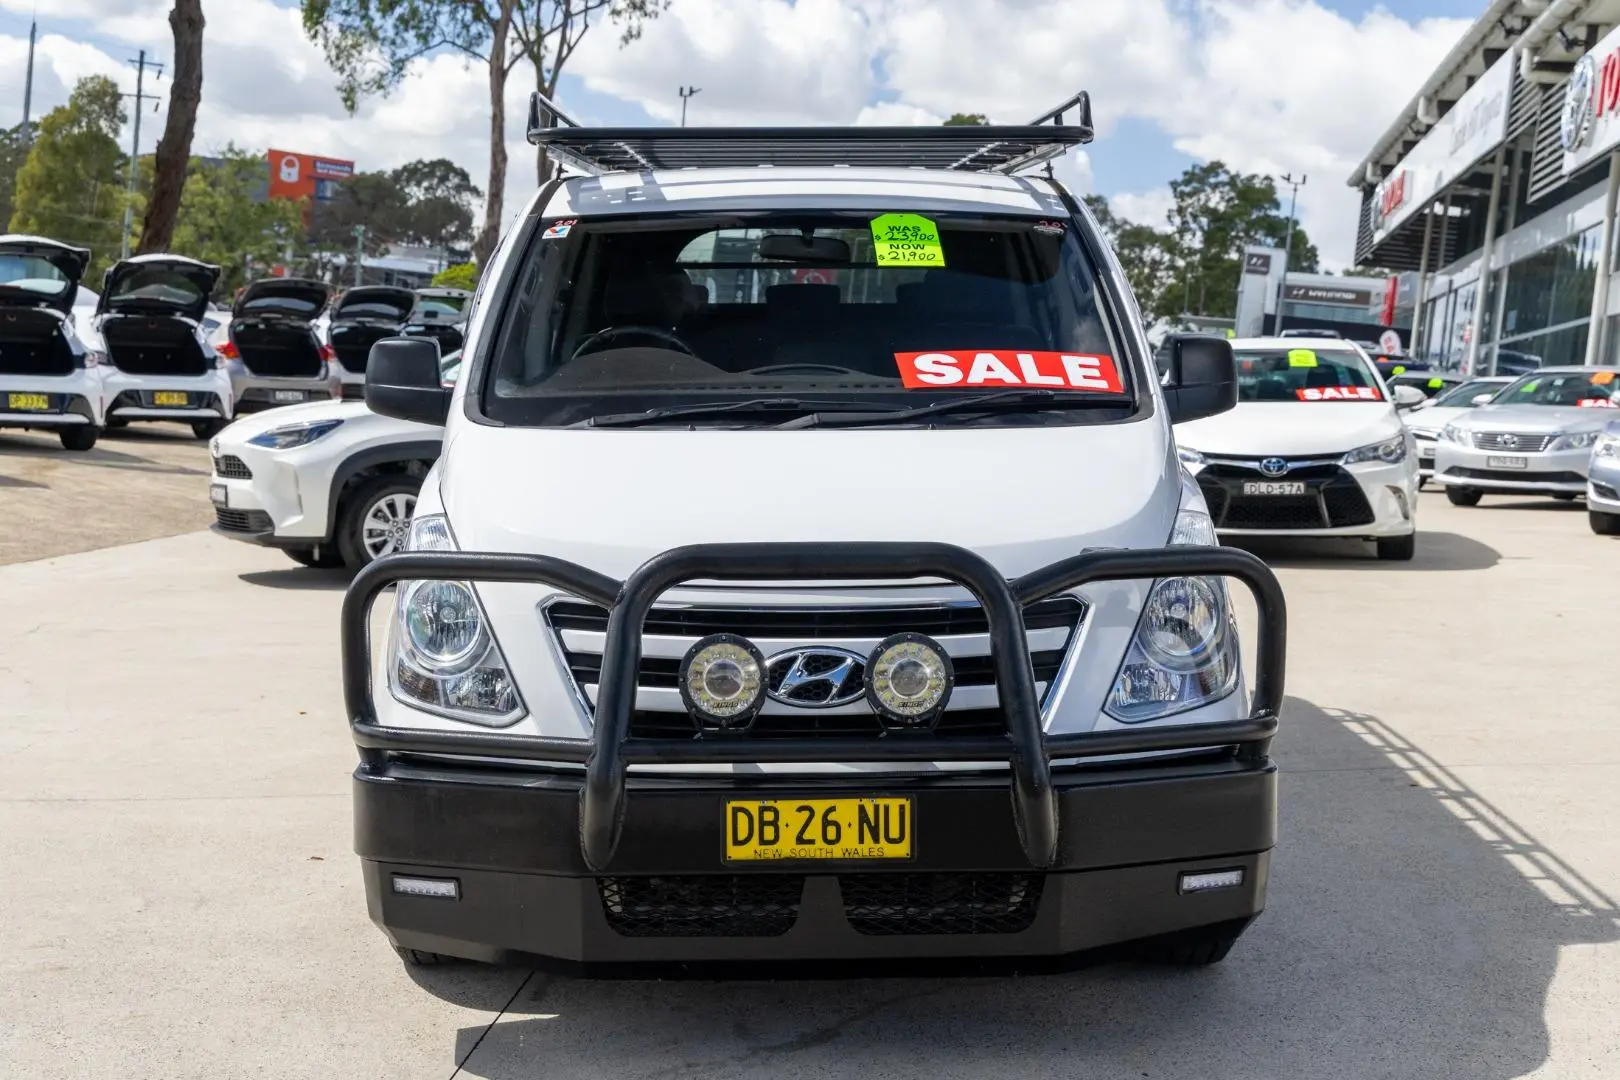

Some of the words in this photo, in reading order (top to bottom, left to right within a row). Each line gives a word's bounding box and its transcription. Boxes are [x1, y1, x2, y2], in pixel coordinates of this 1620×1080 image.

[913, 352, 1110, 389] SALE
[1302, 387, 1377, 400] SALE
[753, 848, 782, 859] NEW
[789, 847, 834, 858] SOUTH
[841, 847, 885, 857] WALES
